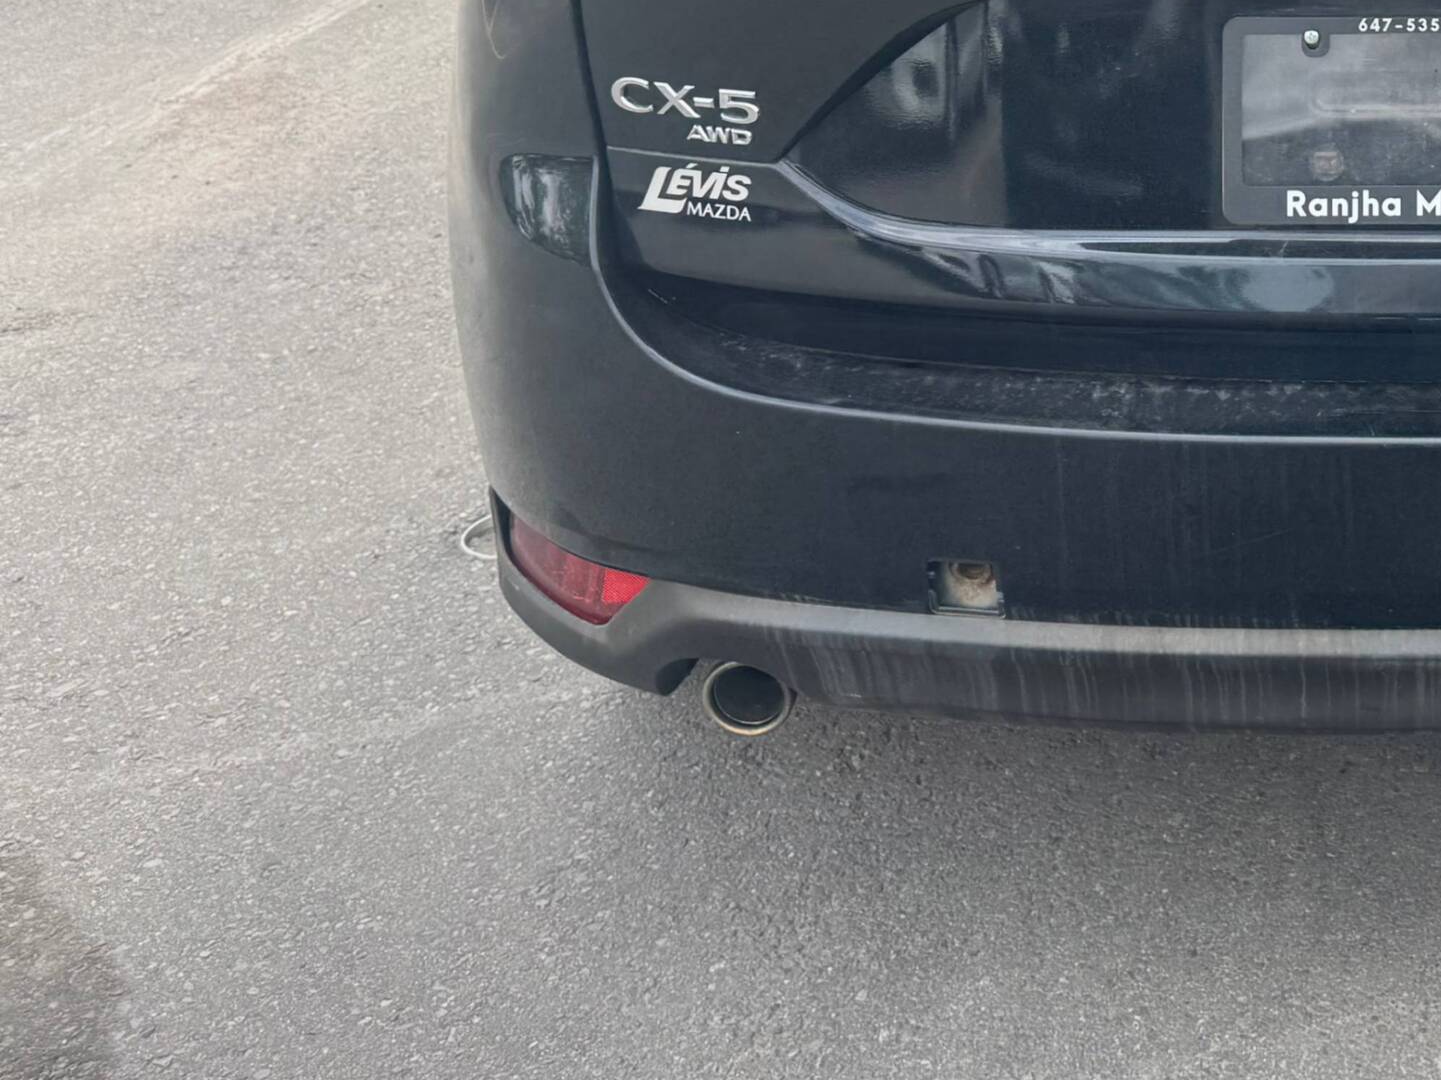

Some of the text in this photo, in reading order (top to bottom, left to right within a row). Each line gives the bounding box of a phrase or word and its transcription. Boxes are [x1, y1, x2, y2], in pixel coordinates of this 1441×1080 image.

[610, 76, 760, 125] CX-5
[686, 124, 752, 146] AWD
[686, 201, 753, 222] MAZDA
[1286, 189, 1402, 224] Ranjha
